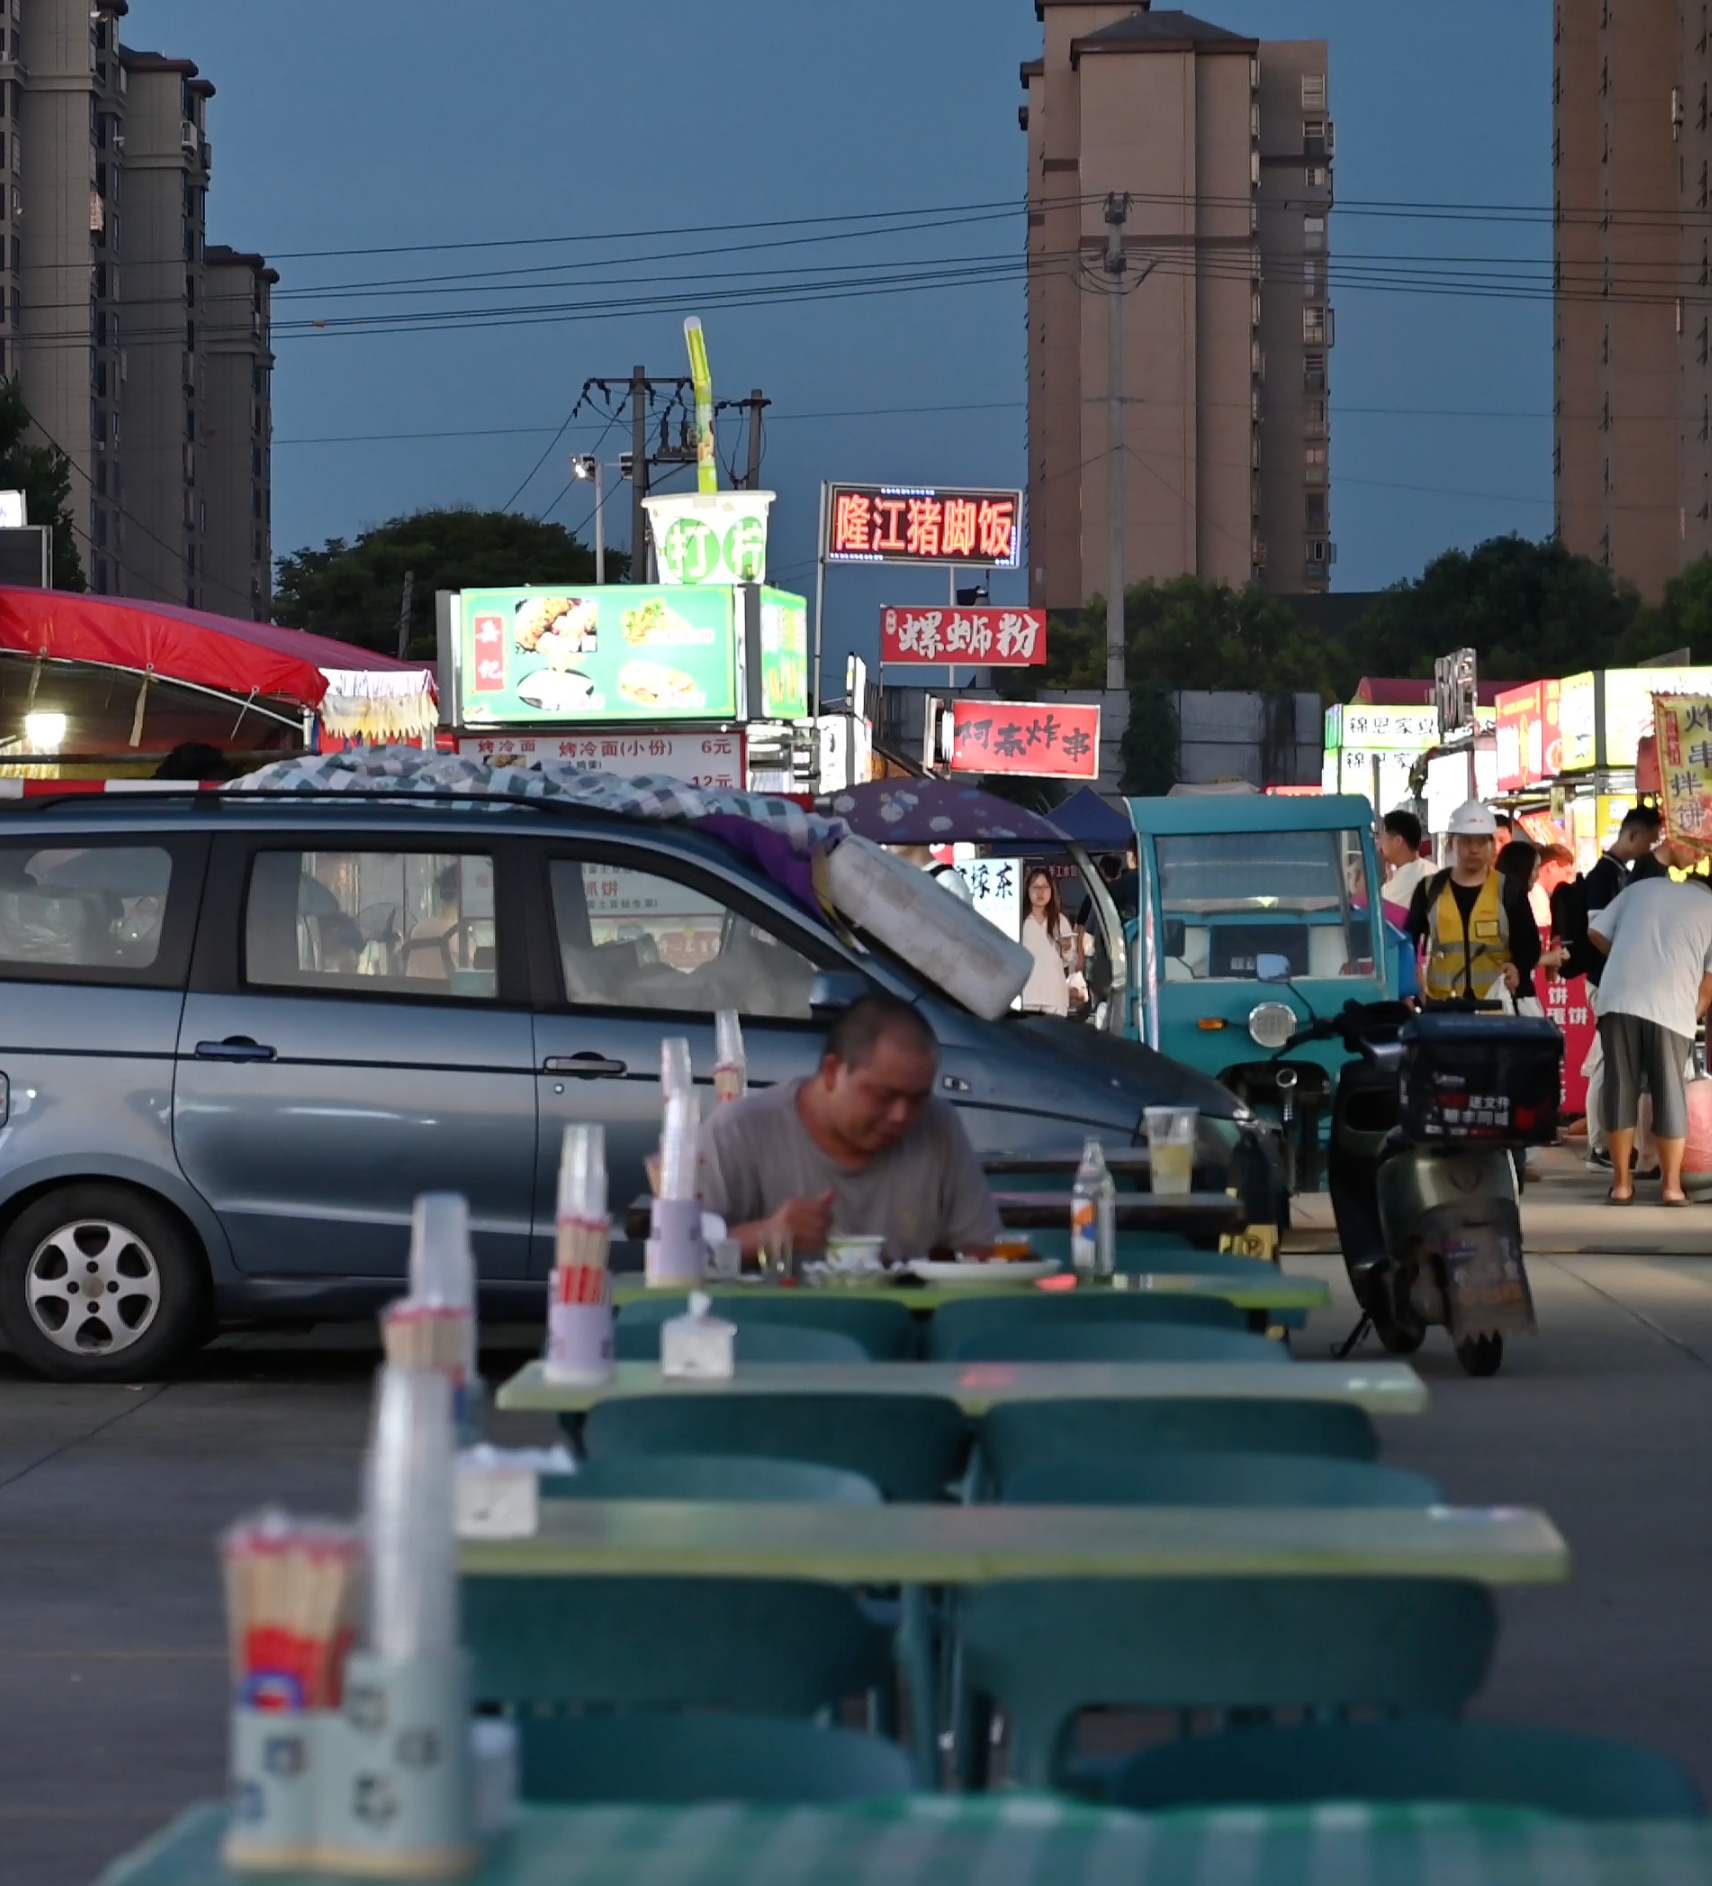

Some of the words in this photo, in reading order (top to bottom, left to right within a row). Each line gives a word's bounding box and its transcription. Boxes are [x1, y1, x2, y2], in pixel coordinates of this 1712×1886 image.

[836, 494, 1014, 556] 隆江猪脚饭
[898, 611, 1041, 659] 螺蛳粉
[478, 740, 536, 753] 烤冷面
[559, 741, 673, 757] 烤冷面(小份)
[701, 740, 732, 754] 6元
